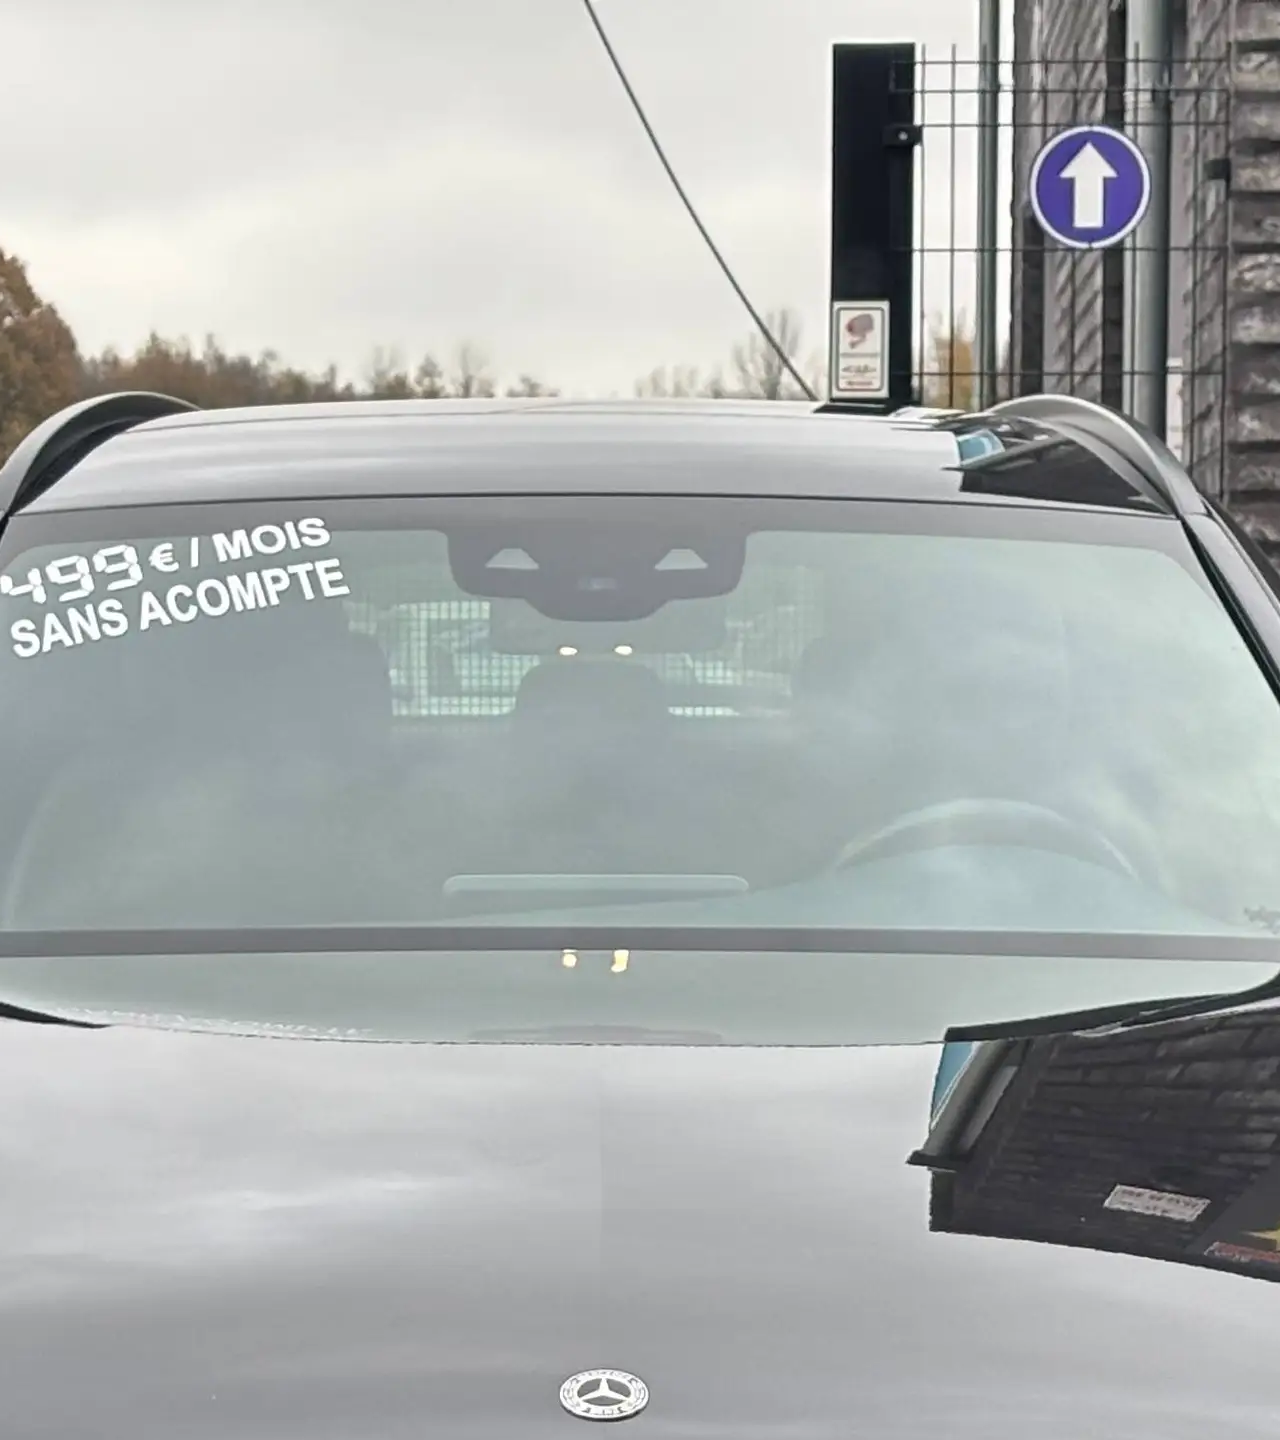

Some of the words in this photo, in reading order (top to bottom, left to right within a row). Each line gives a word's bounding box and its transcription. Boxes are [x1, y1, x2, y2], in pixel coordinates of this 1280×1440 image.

[212, 517, 331, 562] MOIS
[10, 598, 128, 658] SANS
[139, 558, 351, 630] ACOMPTE
